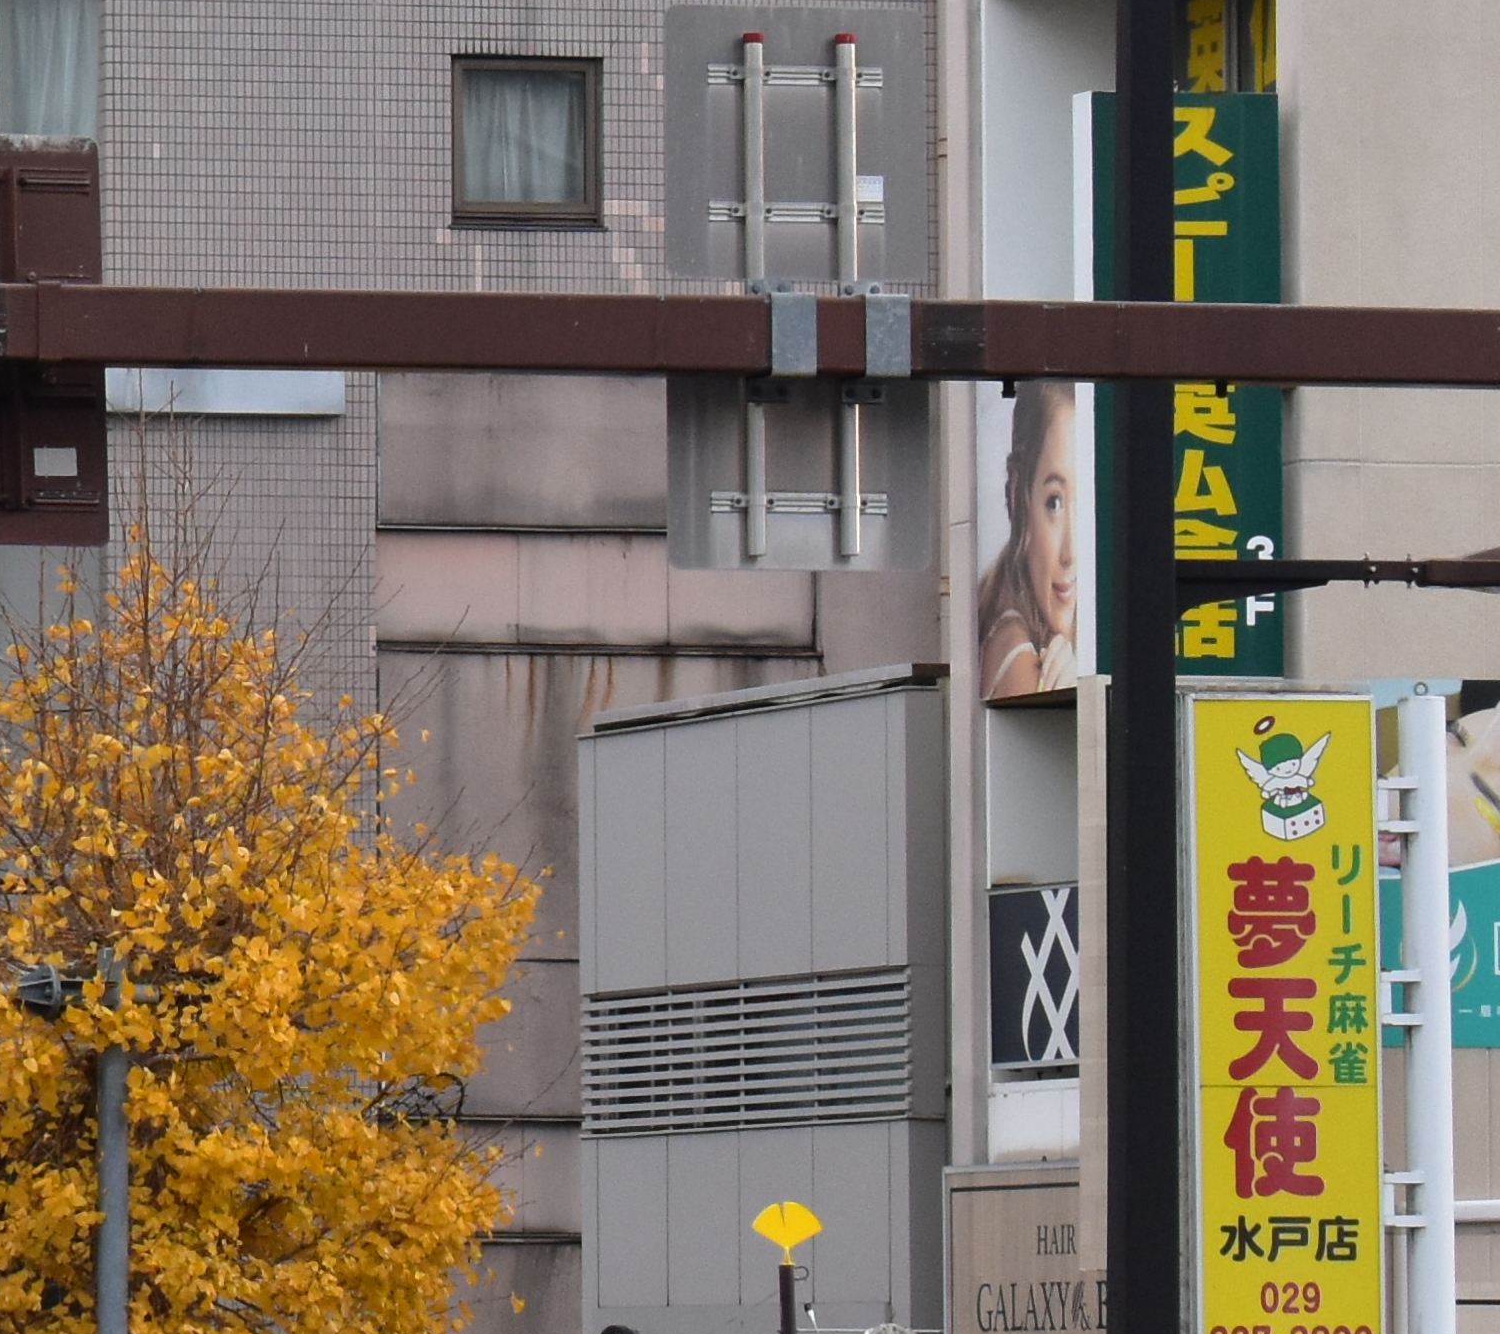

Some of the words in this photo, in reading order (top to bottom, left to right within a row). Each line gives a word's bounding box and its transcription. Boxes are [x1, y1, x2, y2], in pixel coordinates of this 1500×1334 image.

[1326, 843, 1369, 1086] リーチ麻雀
[1224, 855, 1326, 1200] 夢天使
[1036, 1224, 1077, 1255] HAIR
[1219, 1214, 1360, 1263] 水戸店
[976, 1280, 1071, 1333] GALAXY
[1260, 1281, 1322, 1315] 029
